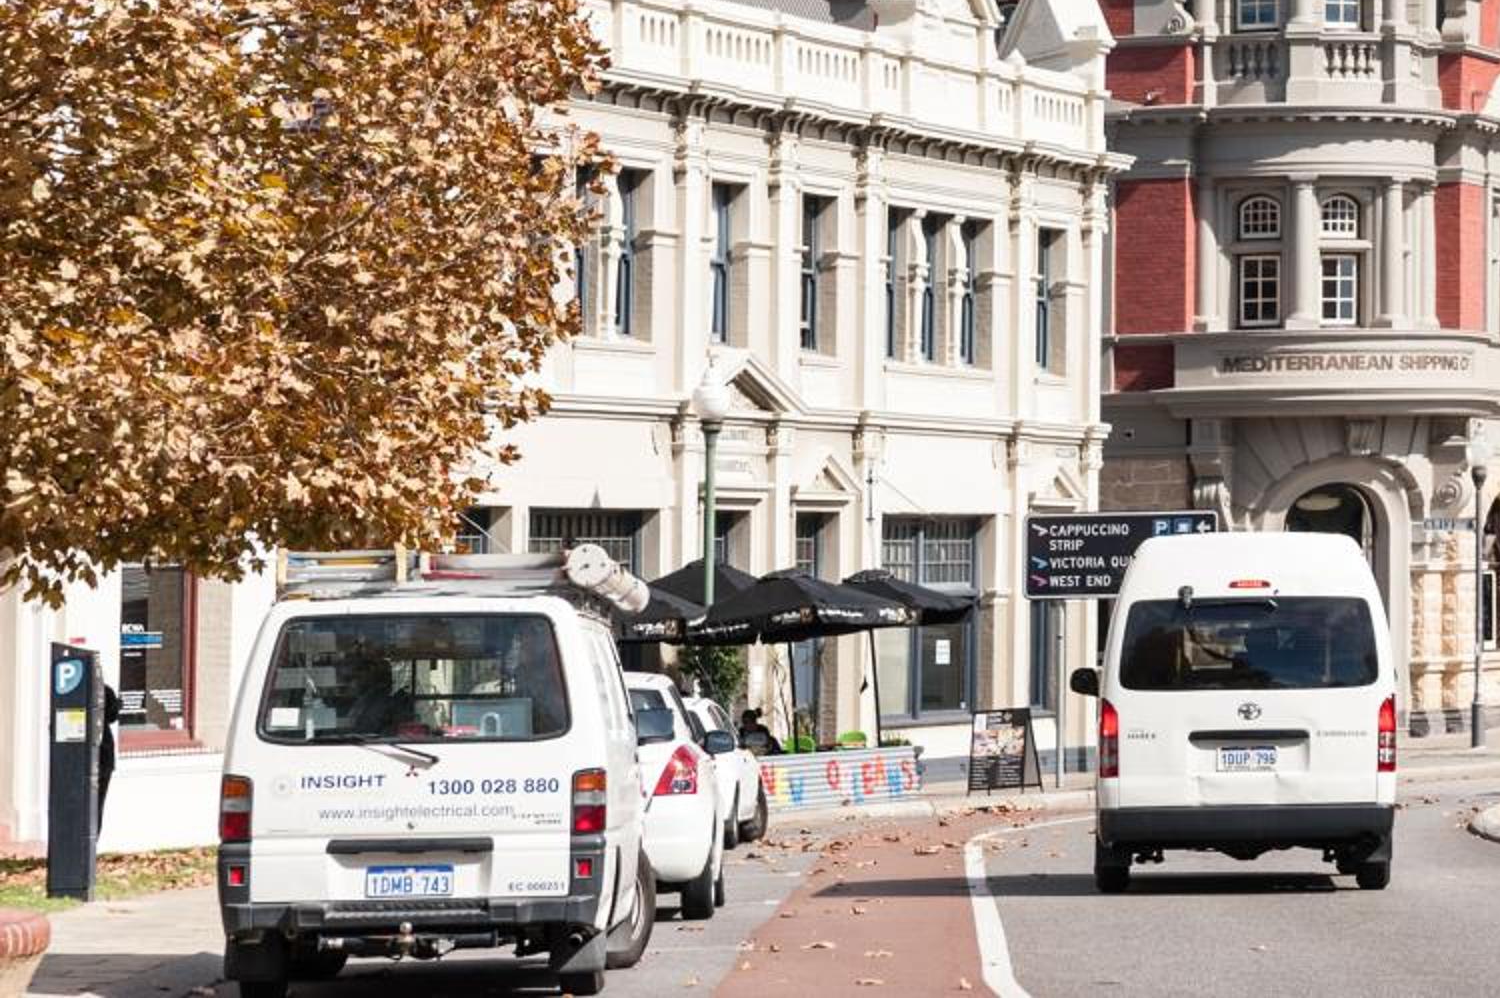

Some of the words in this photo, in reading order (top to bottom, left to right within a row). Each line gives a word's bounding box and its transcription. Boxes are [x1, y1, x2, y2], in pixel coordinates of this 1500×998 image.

[1222, 355, 1393, 372] MEDITERRANEAN
[1399, 355, 1458, 371] SHIPPING
[1049, 523, 1129, 537] CAPPUCCINO
[1049, 539, 1085, 551] STRIP
[1049, 555, 1105, 569] VICTORIA
[1049, 575, 1081, 587] WEST
[1086, 574, 1112, 587] END
[300, 775, 386, 789] INSIGHT
[429, 779, 474, 795] 1300
[481, 779, 517, 794] 028
[523, 777, 560, 794] 880
[373, 875, 413, 893] 1DMB
[422, 875, 450, 893] 743
